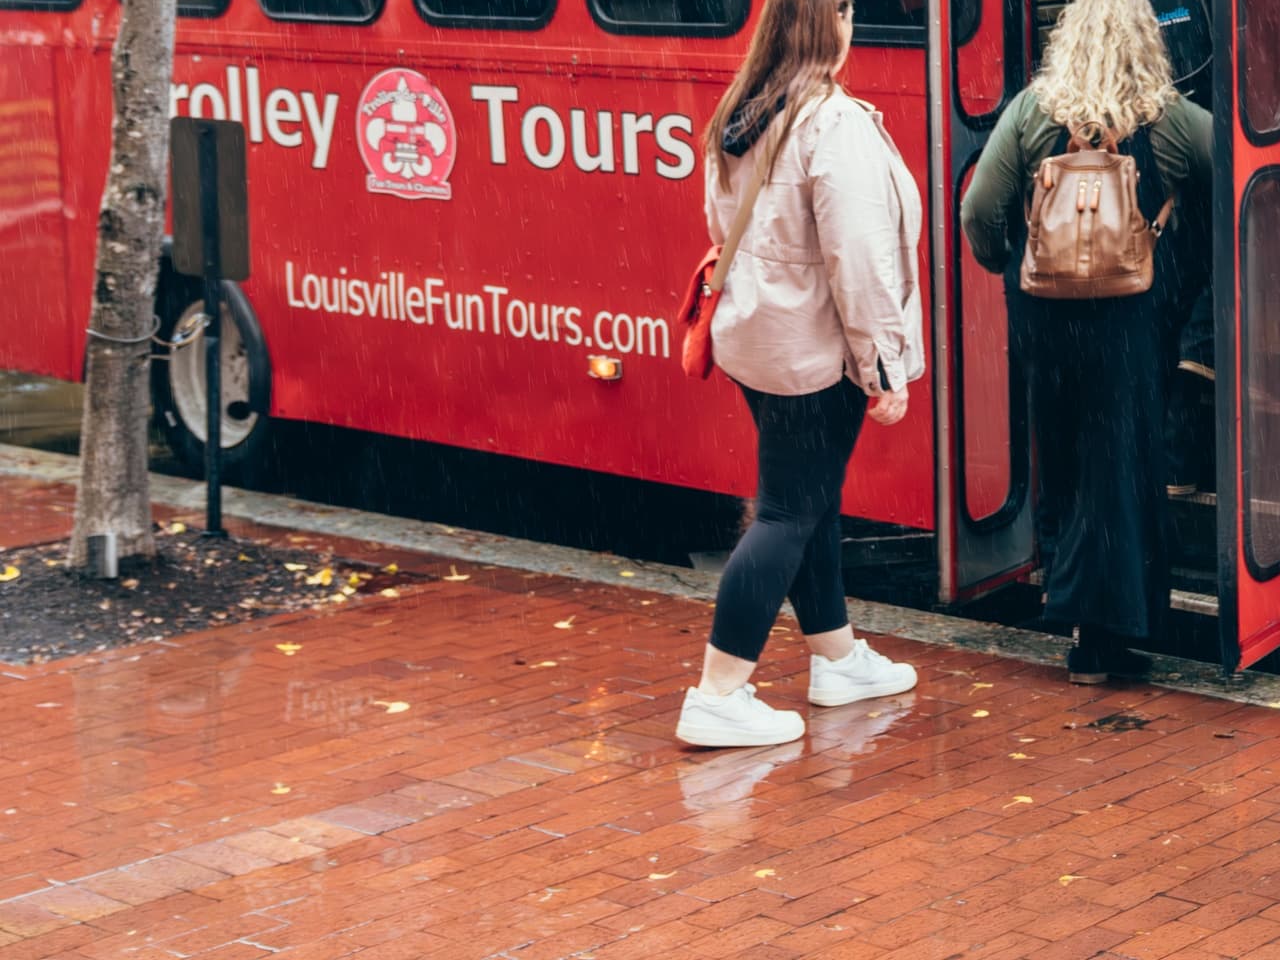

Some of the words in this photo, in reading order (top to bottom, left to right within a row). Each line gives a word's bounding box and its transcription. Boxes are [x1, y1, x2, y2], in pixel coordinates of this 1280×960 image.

[167, 65, 341, 169] rolley
[470, 84, 697, 180] Tours
[285, 261, 671, 358] LouisvilleFunTours.com
